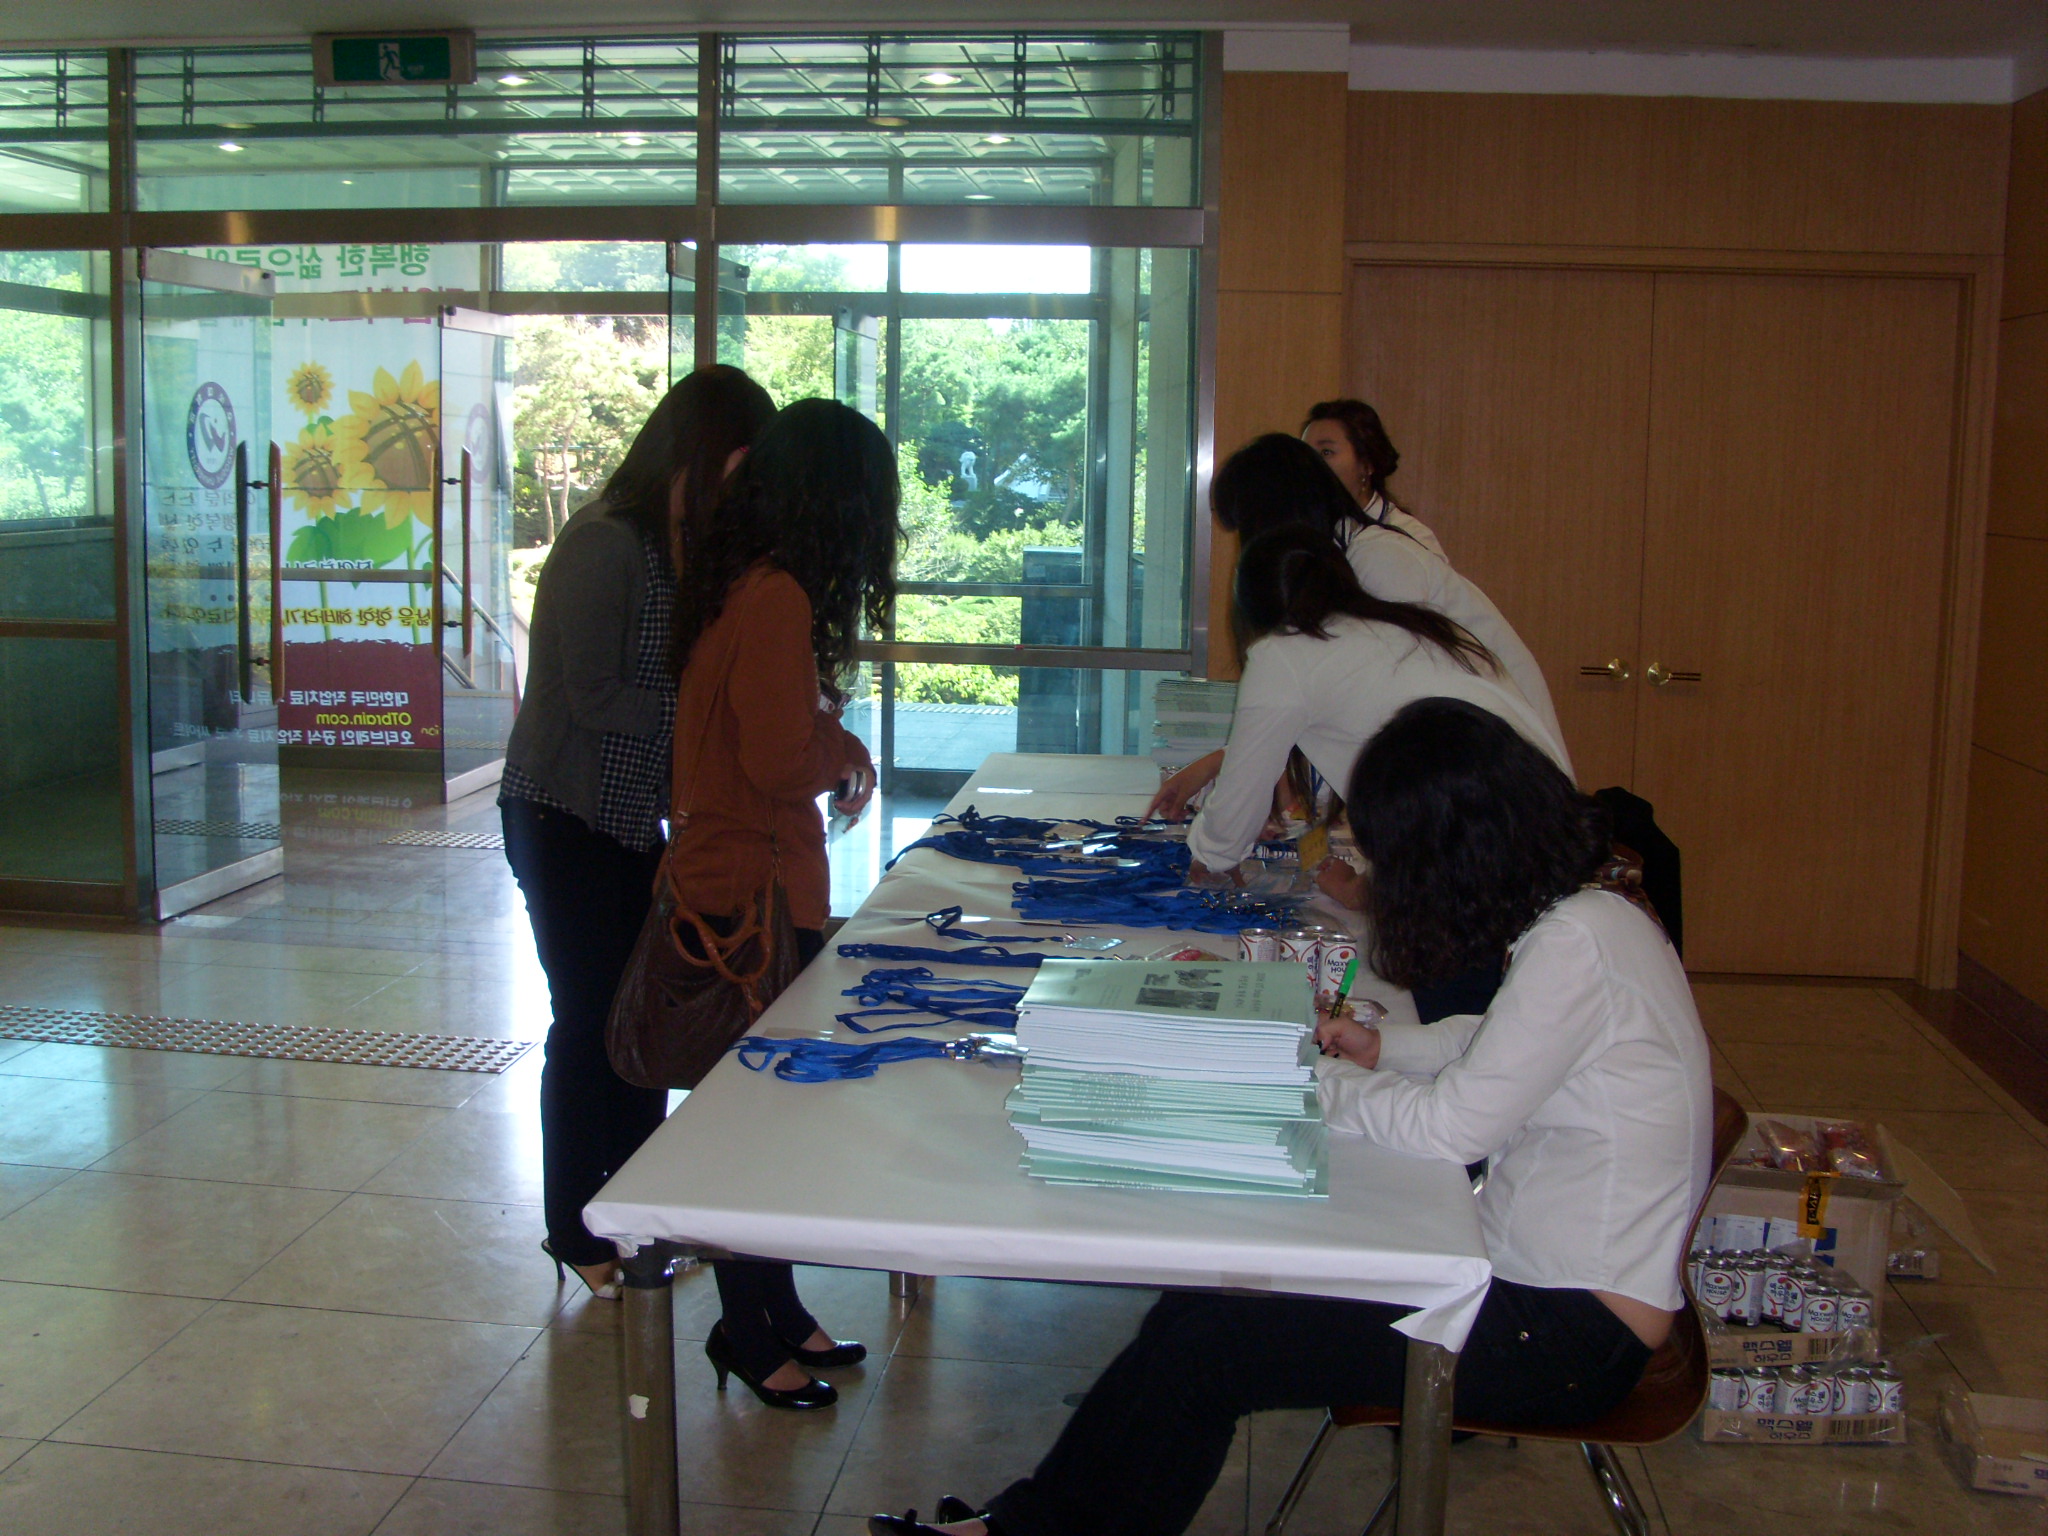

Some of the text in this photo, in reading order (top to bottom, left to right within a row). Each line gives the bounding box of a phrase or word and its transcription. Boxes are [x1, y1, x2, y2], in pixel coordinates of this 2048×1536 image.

[1743, 1339, 1793, 1353] 맥스웰
[1753, 1352, 1792, 1363] 하우스
[1757, 1417, 1814, 1431] 맥스웰
